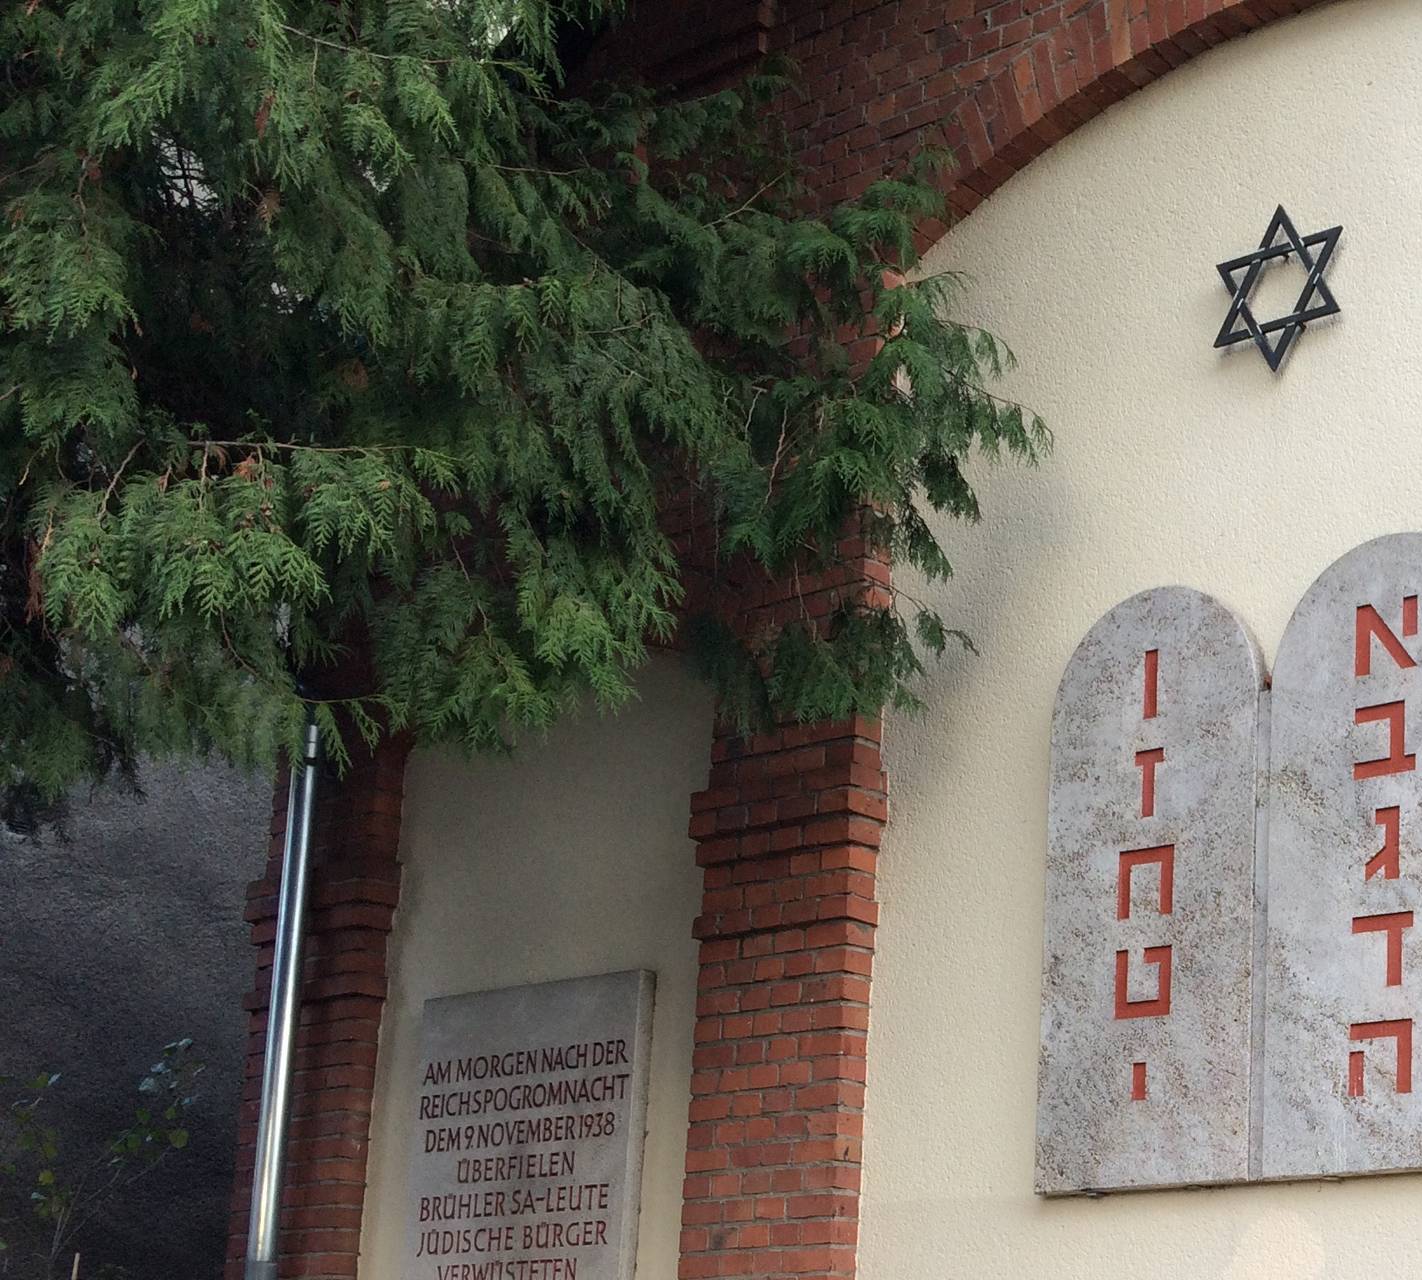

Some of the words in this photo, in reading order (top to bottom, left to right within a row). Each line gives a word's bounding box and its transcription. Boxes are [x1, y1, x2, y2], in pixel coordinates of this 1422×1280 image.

[423, 1061, 451, 1086] AM
[456, 1050, 537, 1082] MORGEN
[541, 1044, 588, 1073] NACH
[592, 1039, 629, 1067] DER
[419, 1074, 630, 1120] REICHSPOGROMNACHT
[425, 1126, 461, 1153] DEM
[578, 1112, 616, 1139] 1938
[457, 1151, 575, 1184] ÜBERFIELEN
[420, 1192, 505, 1222] BRÜHLER
[511, 1184, 610, 1215] SA-LEUTE
[416, 1226, 514, 1257] JÜDISCHE
[523, 1221, 608, 1249] BÜRGER
